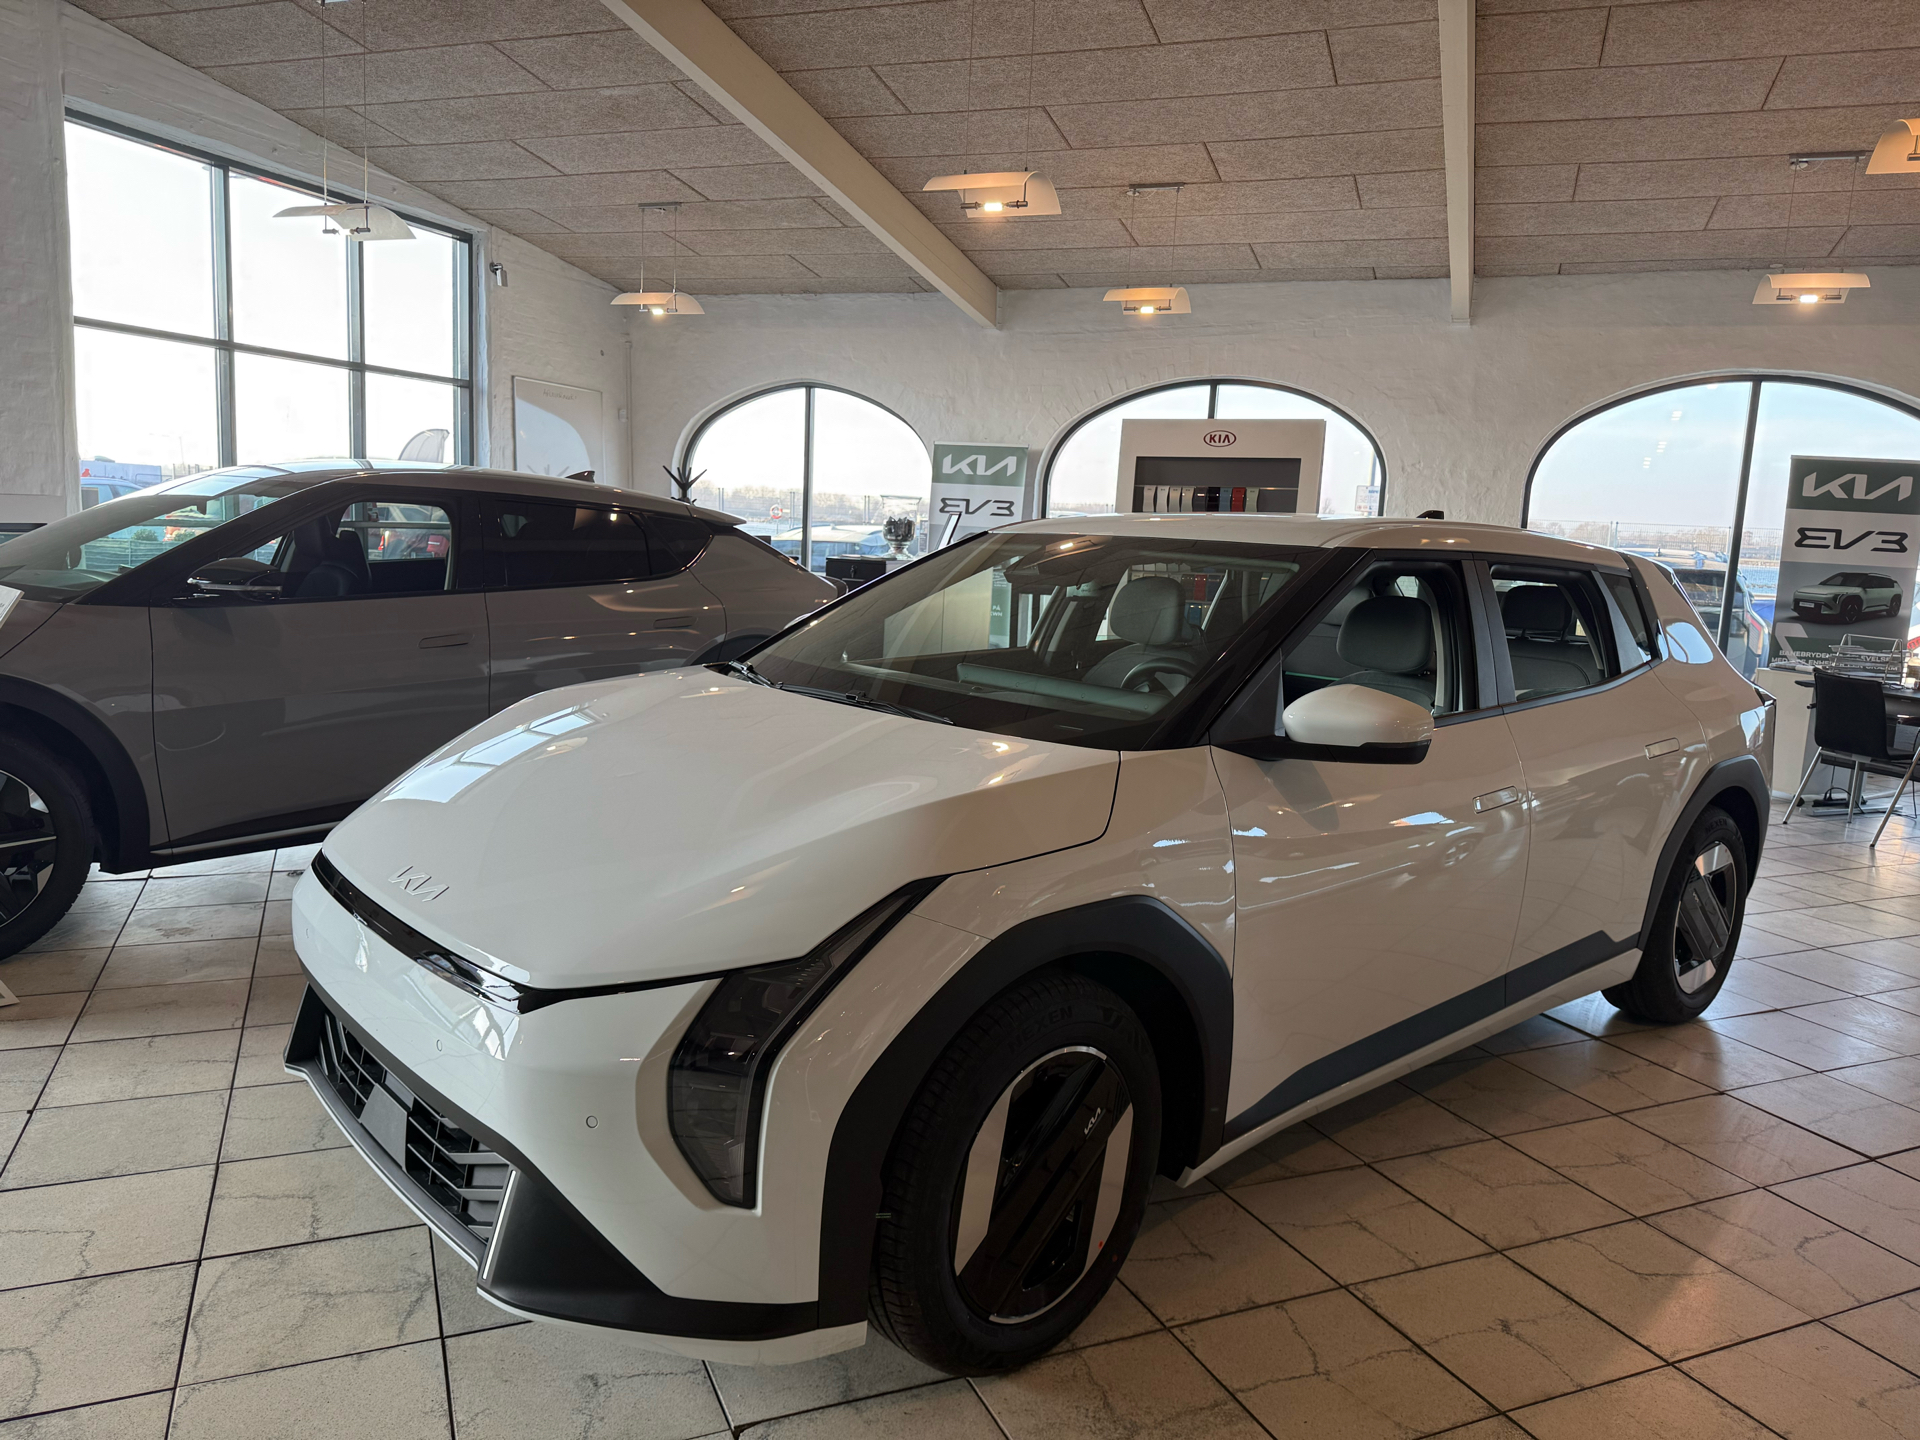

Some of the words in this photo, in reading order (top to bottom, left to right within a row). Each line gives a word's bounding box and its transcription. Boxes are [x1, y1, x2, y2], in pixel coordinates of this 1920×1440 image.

[1209, 434, 1230, 443] KIA
[942, 453, 1017, 477] KIA
[1802, 472, 1913, 501] KIA
[939, 497, 1015, 517] EV3
[1794, 527, 1908, 553] EV3
[1705, 818, 1728, 835] NEXEN
[388, 865, 450, 902] KIA
[1007, 1005, 1073, 1054] NEXEN
[1084, 1107, 1101, 1135] KIA
